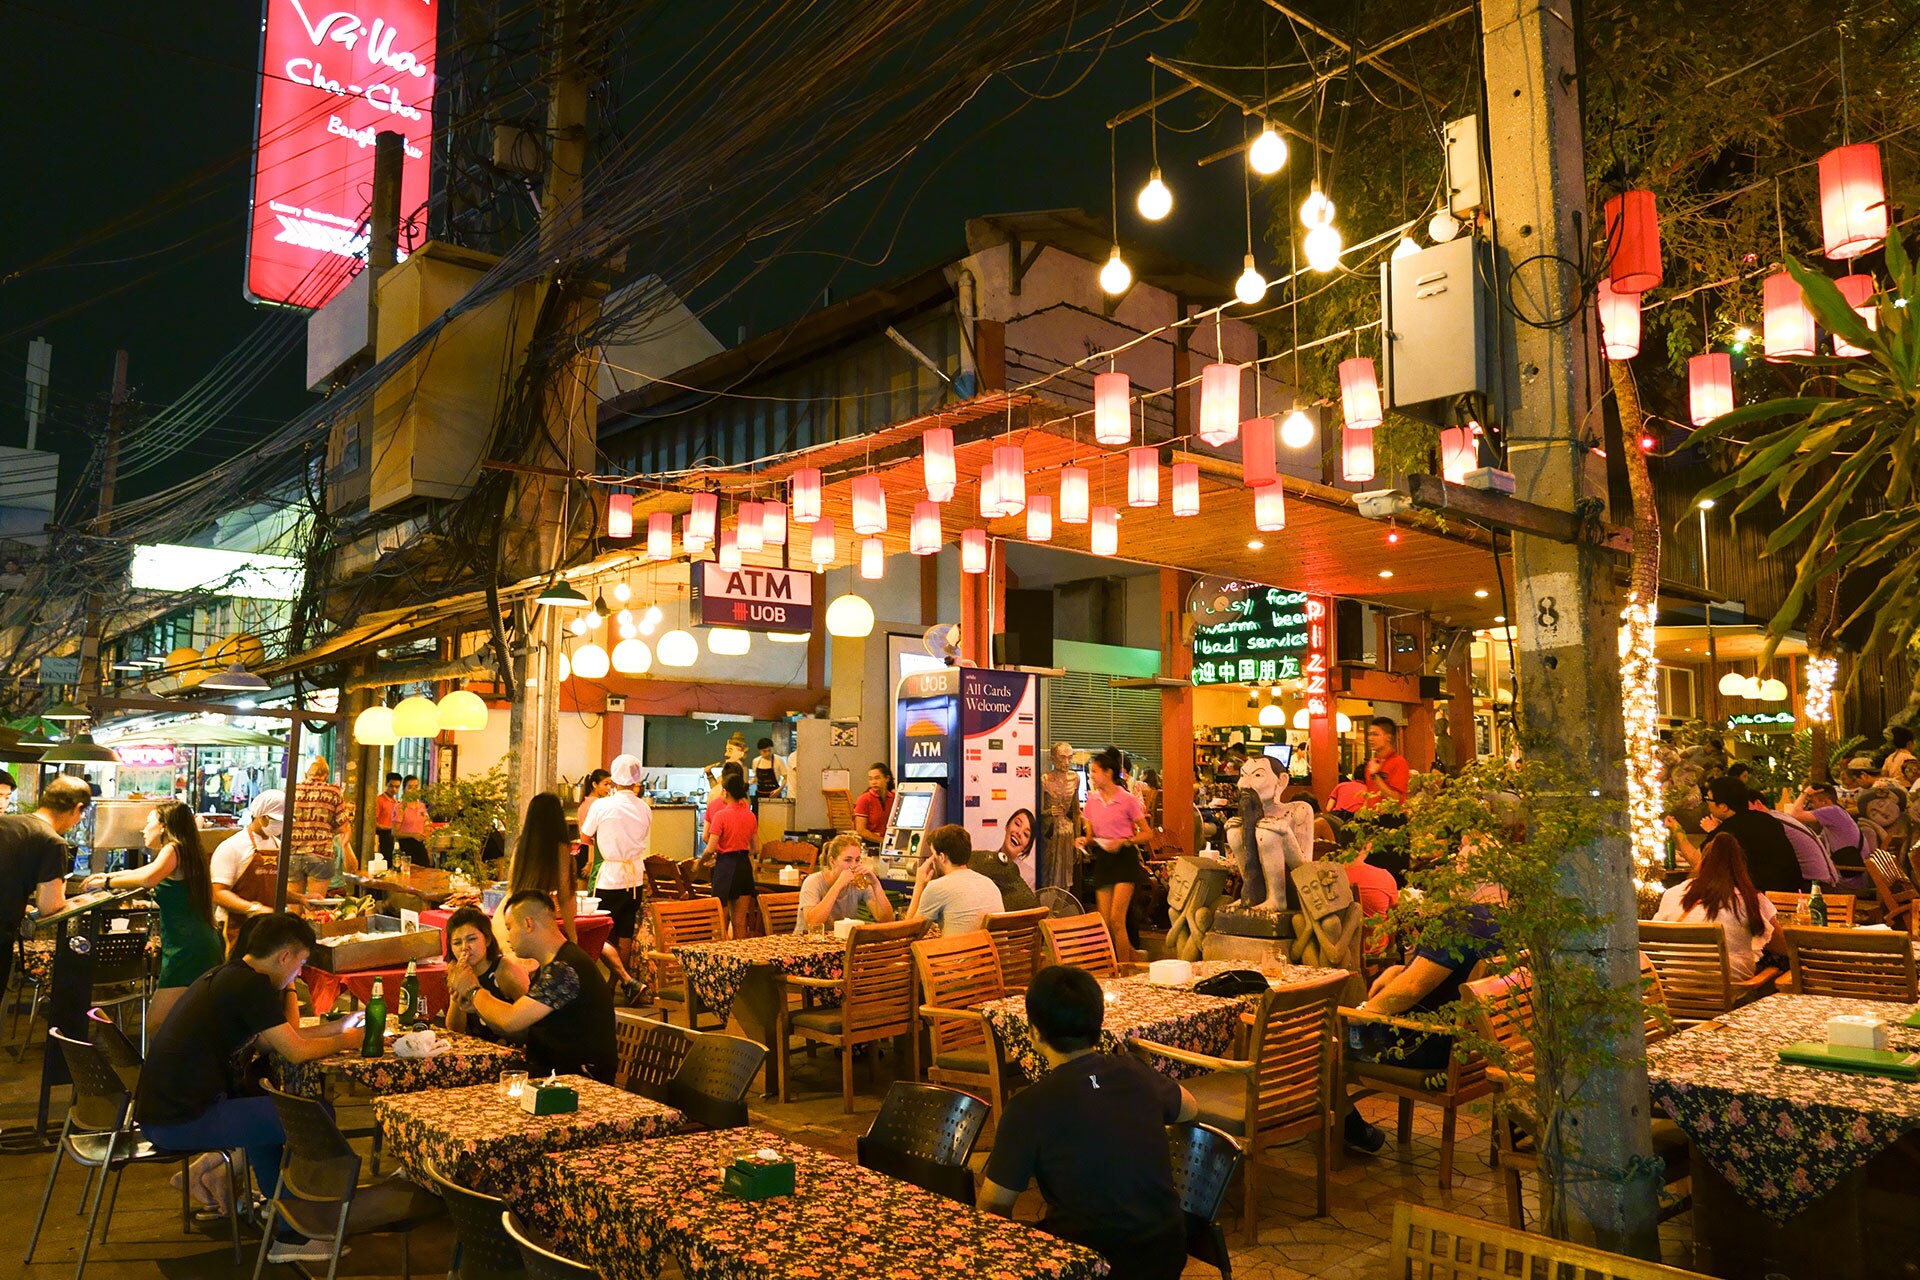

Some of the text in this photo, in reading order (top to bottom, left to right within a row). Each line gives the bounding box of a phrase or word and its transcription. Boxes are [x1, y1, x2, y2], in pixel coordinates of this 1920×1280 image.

[290, 0, 427, 77] Villa
[725, 570, 793, 599] ATM
[750, 604, 786, 623] UOB
[1537, 596, 1560, 628] 8
[1191, 655, 1299, 686] 迎中国朋友
[920, 674, 948, 692] UOB
[966, 682, 1012, 697] All Cards
[966, 697, 1012, 713] Welcome
[912, 741, 942, 758] ATM
